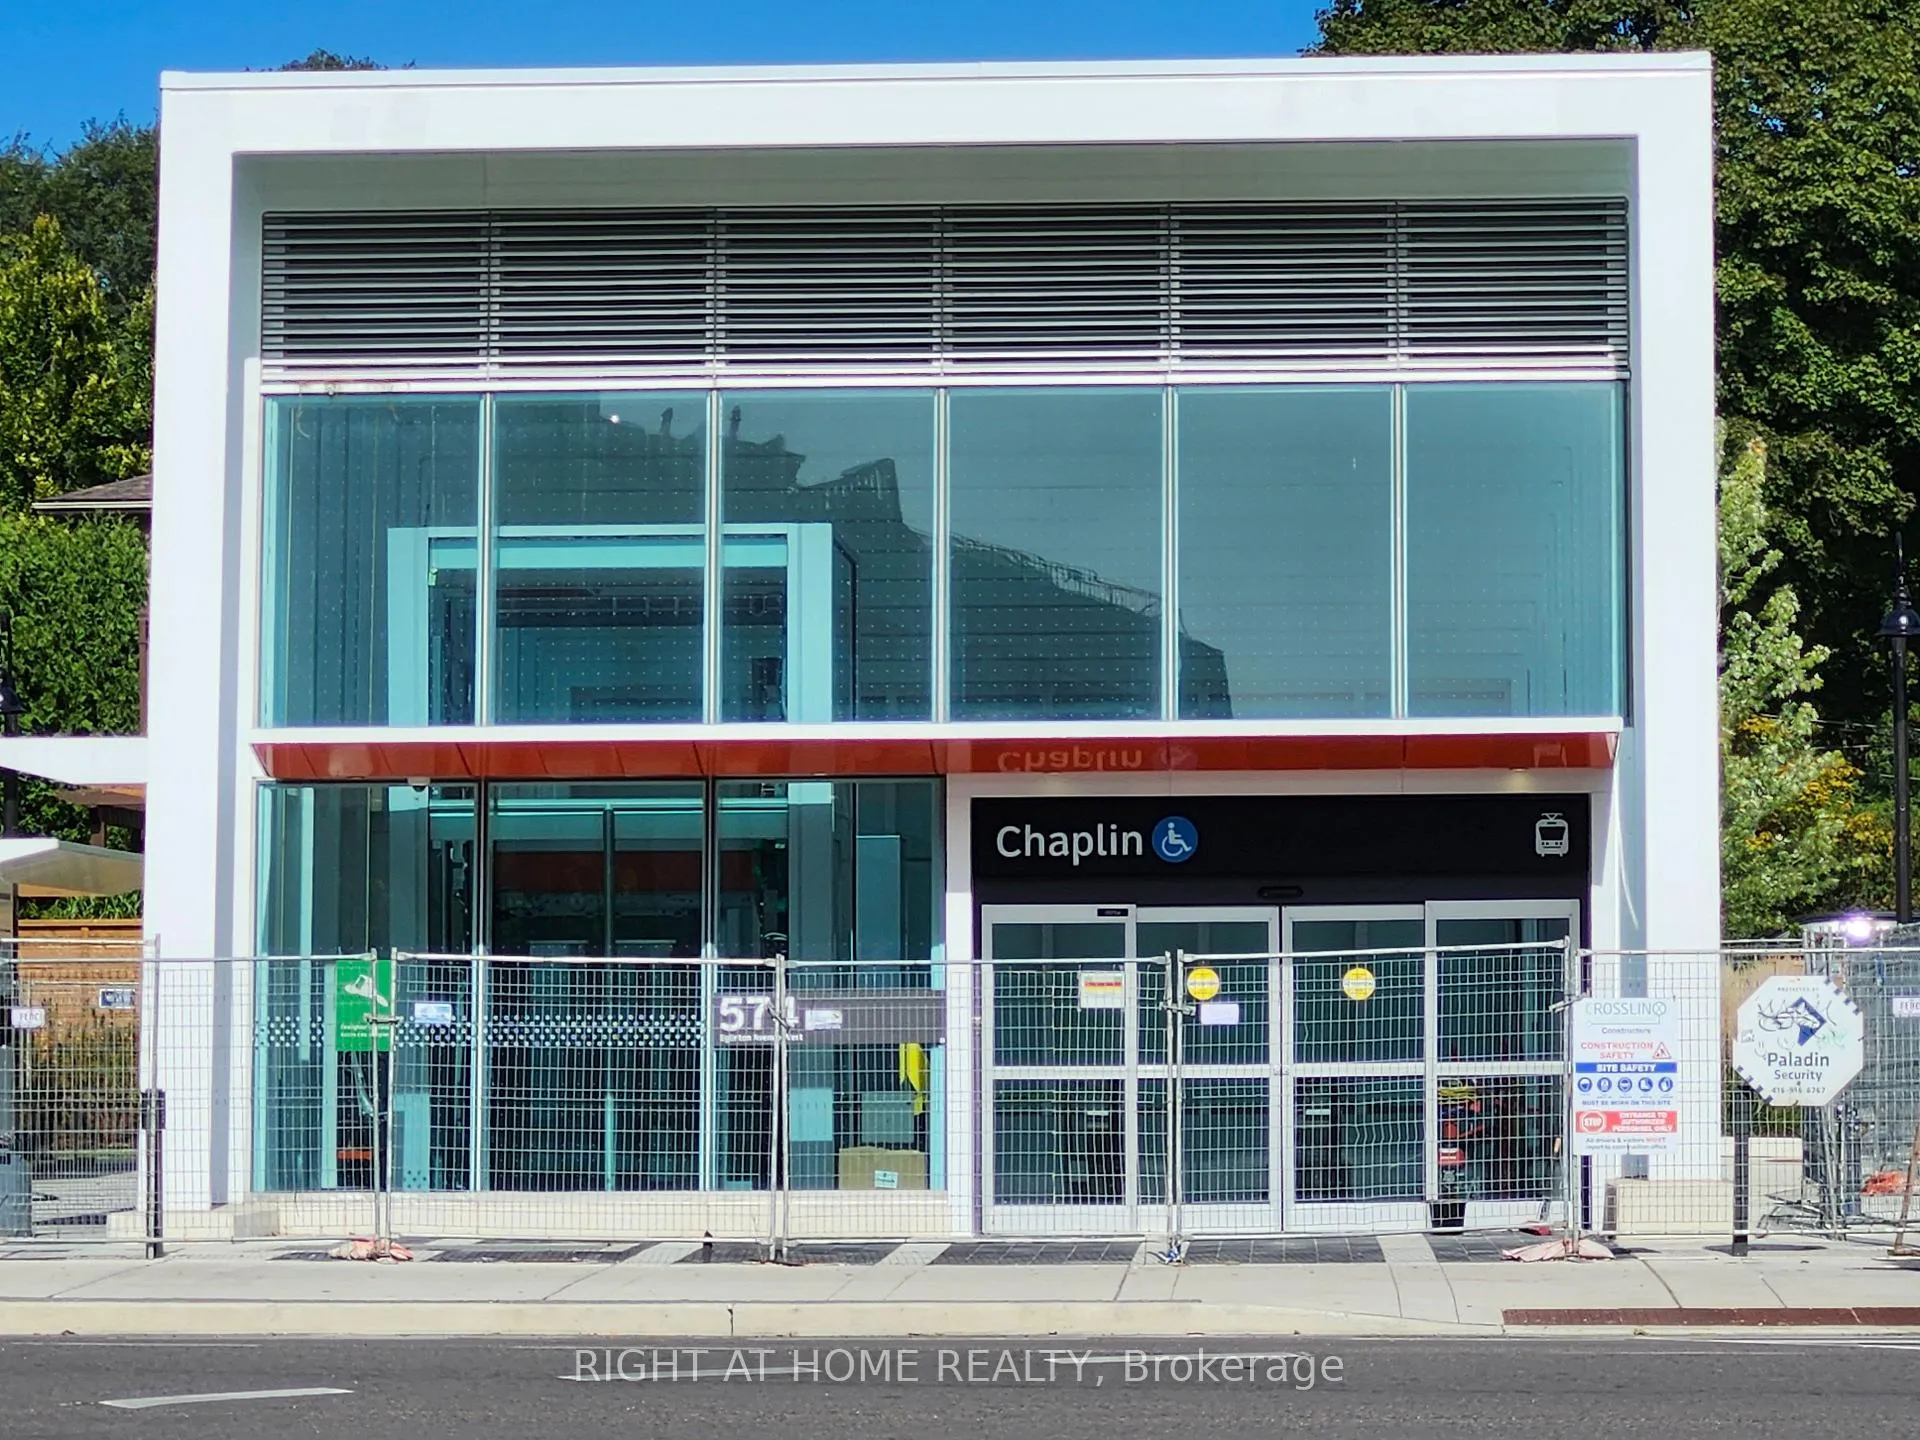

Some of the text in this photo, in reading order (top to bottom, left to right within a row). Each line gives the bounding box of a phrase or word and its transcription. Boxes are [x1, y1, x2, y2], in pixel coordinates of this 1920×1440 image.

[997, 822, 1143, 866] Chaplin
[1580, 1042, 1654, 1050] CONSTRUCTION
[1767, 1052, 1830, 1067] Paladin
[1596, 1064, 1656, 1072] SITE SAFETY
[1774, 1069, 1823, 1081] Security
